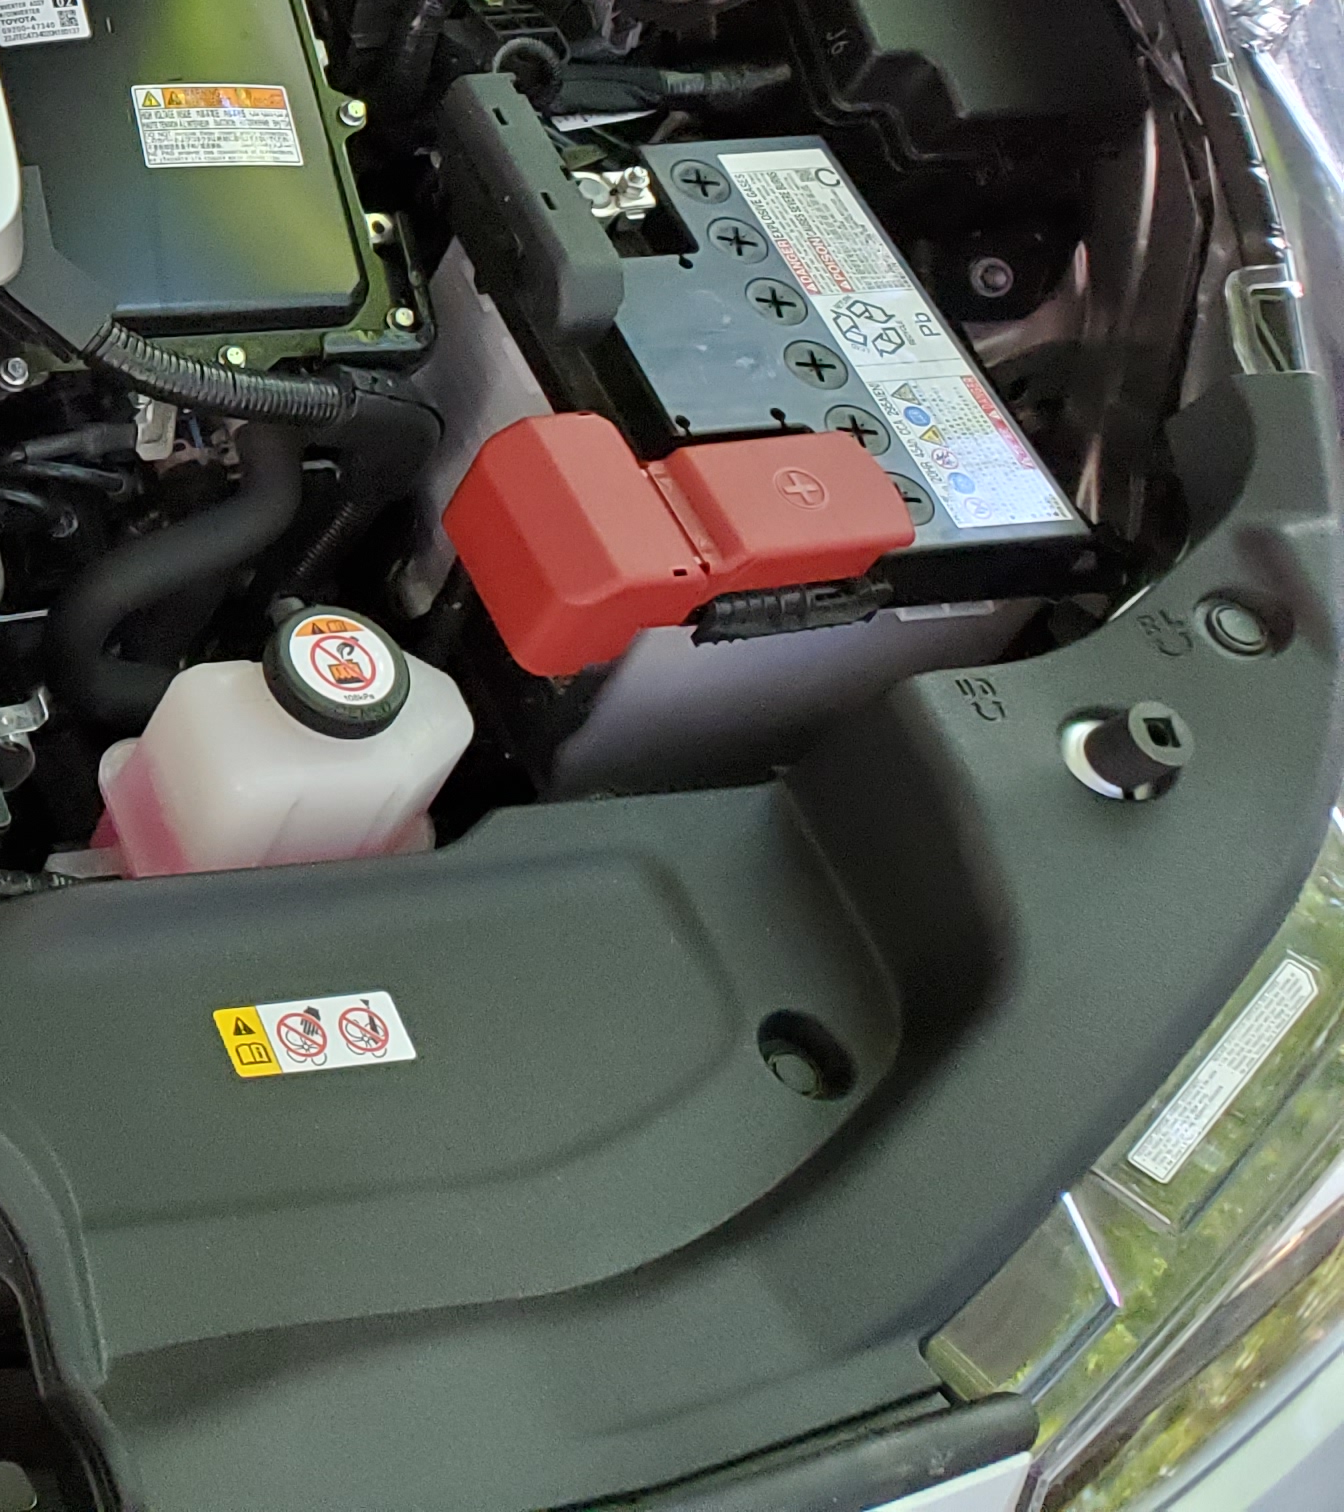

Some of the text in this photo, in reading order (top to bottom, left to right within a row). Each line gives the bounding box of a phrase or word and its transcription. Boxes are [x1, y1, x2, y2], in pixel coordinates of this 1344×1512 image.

[0, 15, 36, 25] TOYOTA
[732, 173, 814, 282] DANGER EXPLOSIVE GASES
[808, 237, 847, 280] POISON
[915, 312, 941, 336] Pb
[892, 420, 912, 435] CCA
